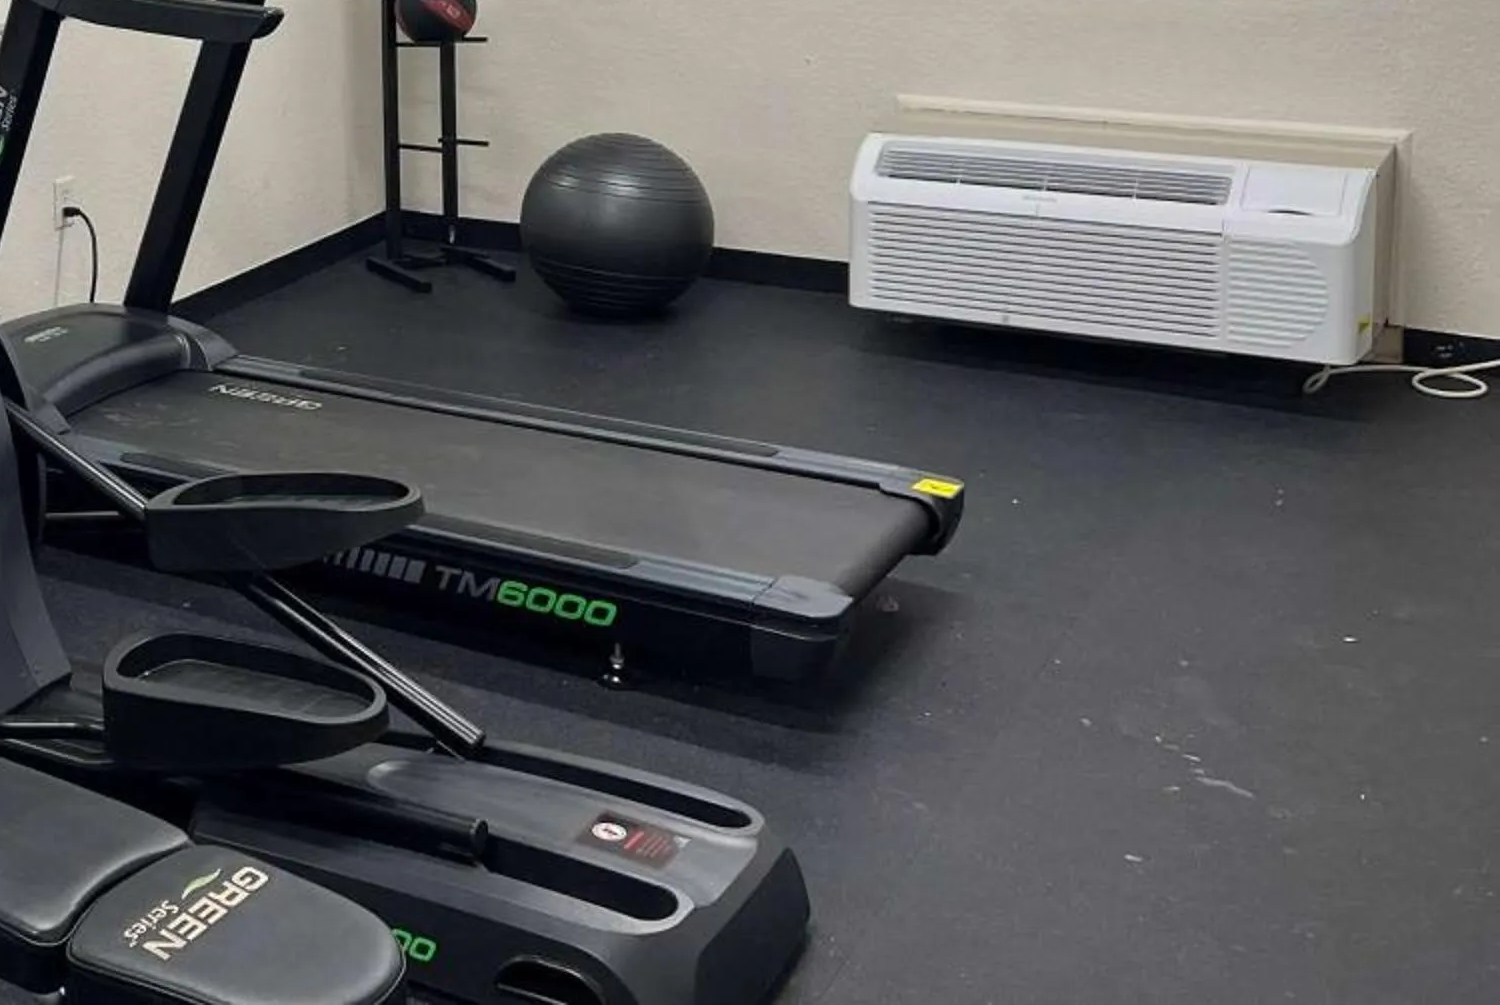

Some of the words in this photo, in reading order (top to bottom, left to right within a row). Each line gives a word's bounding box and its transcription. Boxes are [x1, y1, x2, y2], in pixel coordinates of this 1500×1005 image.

[434, 565, 617, 626] TM6000
[123, 899, 180, 944] Series
[142, 866, 270, 962] GREEN
